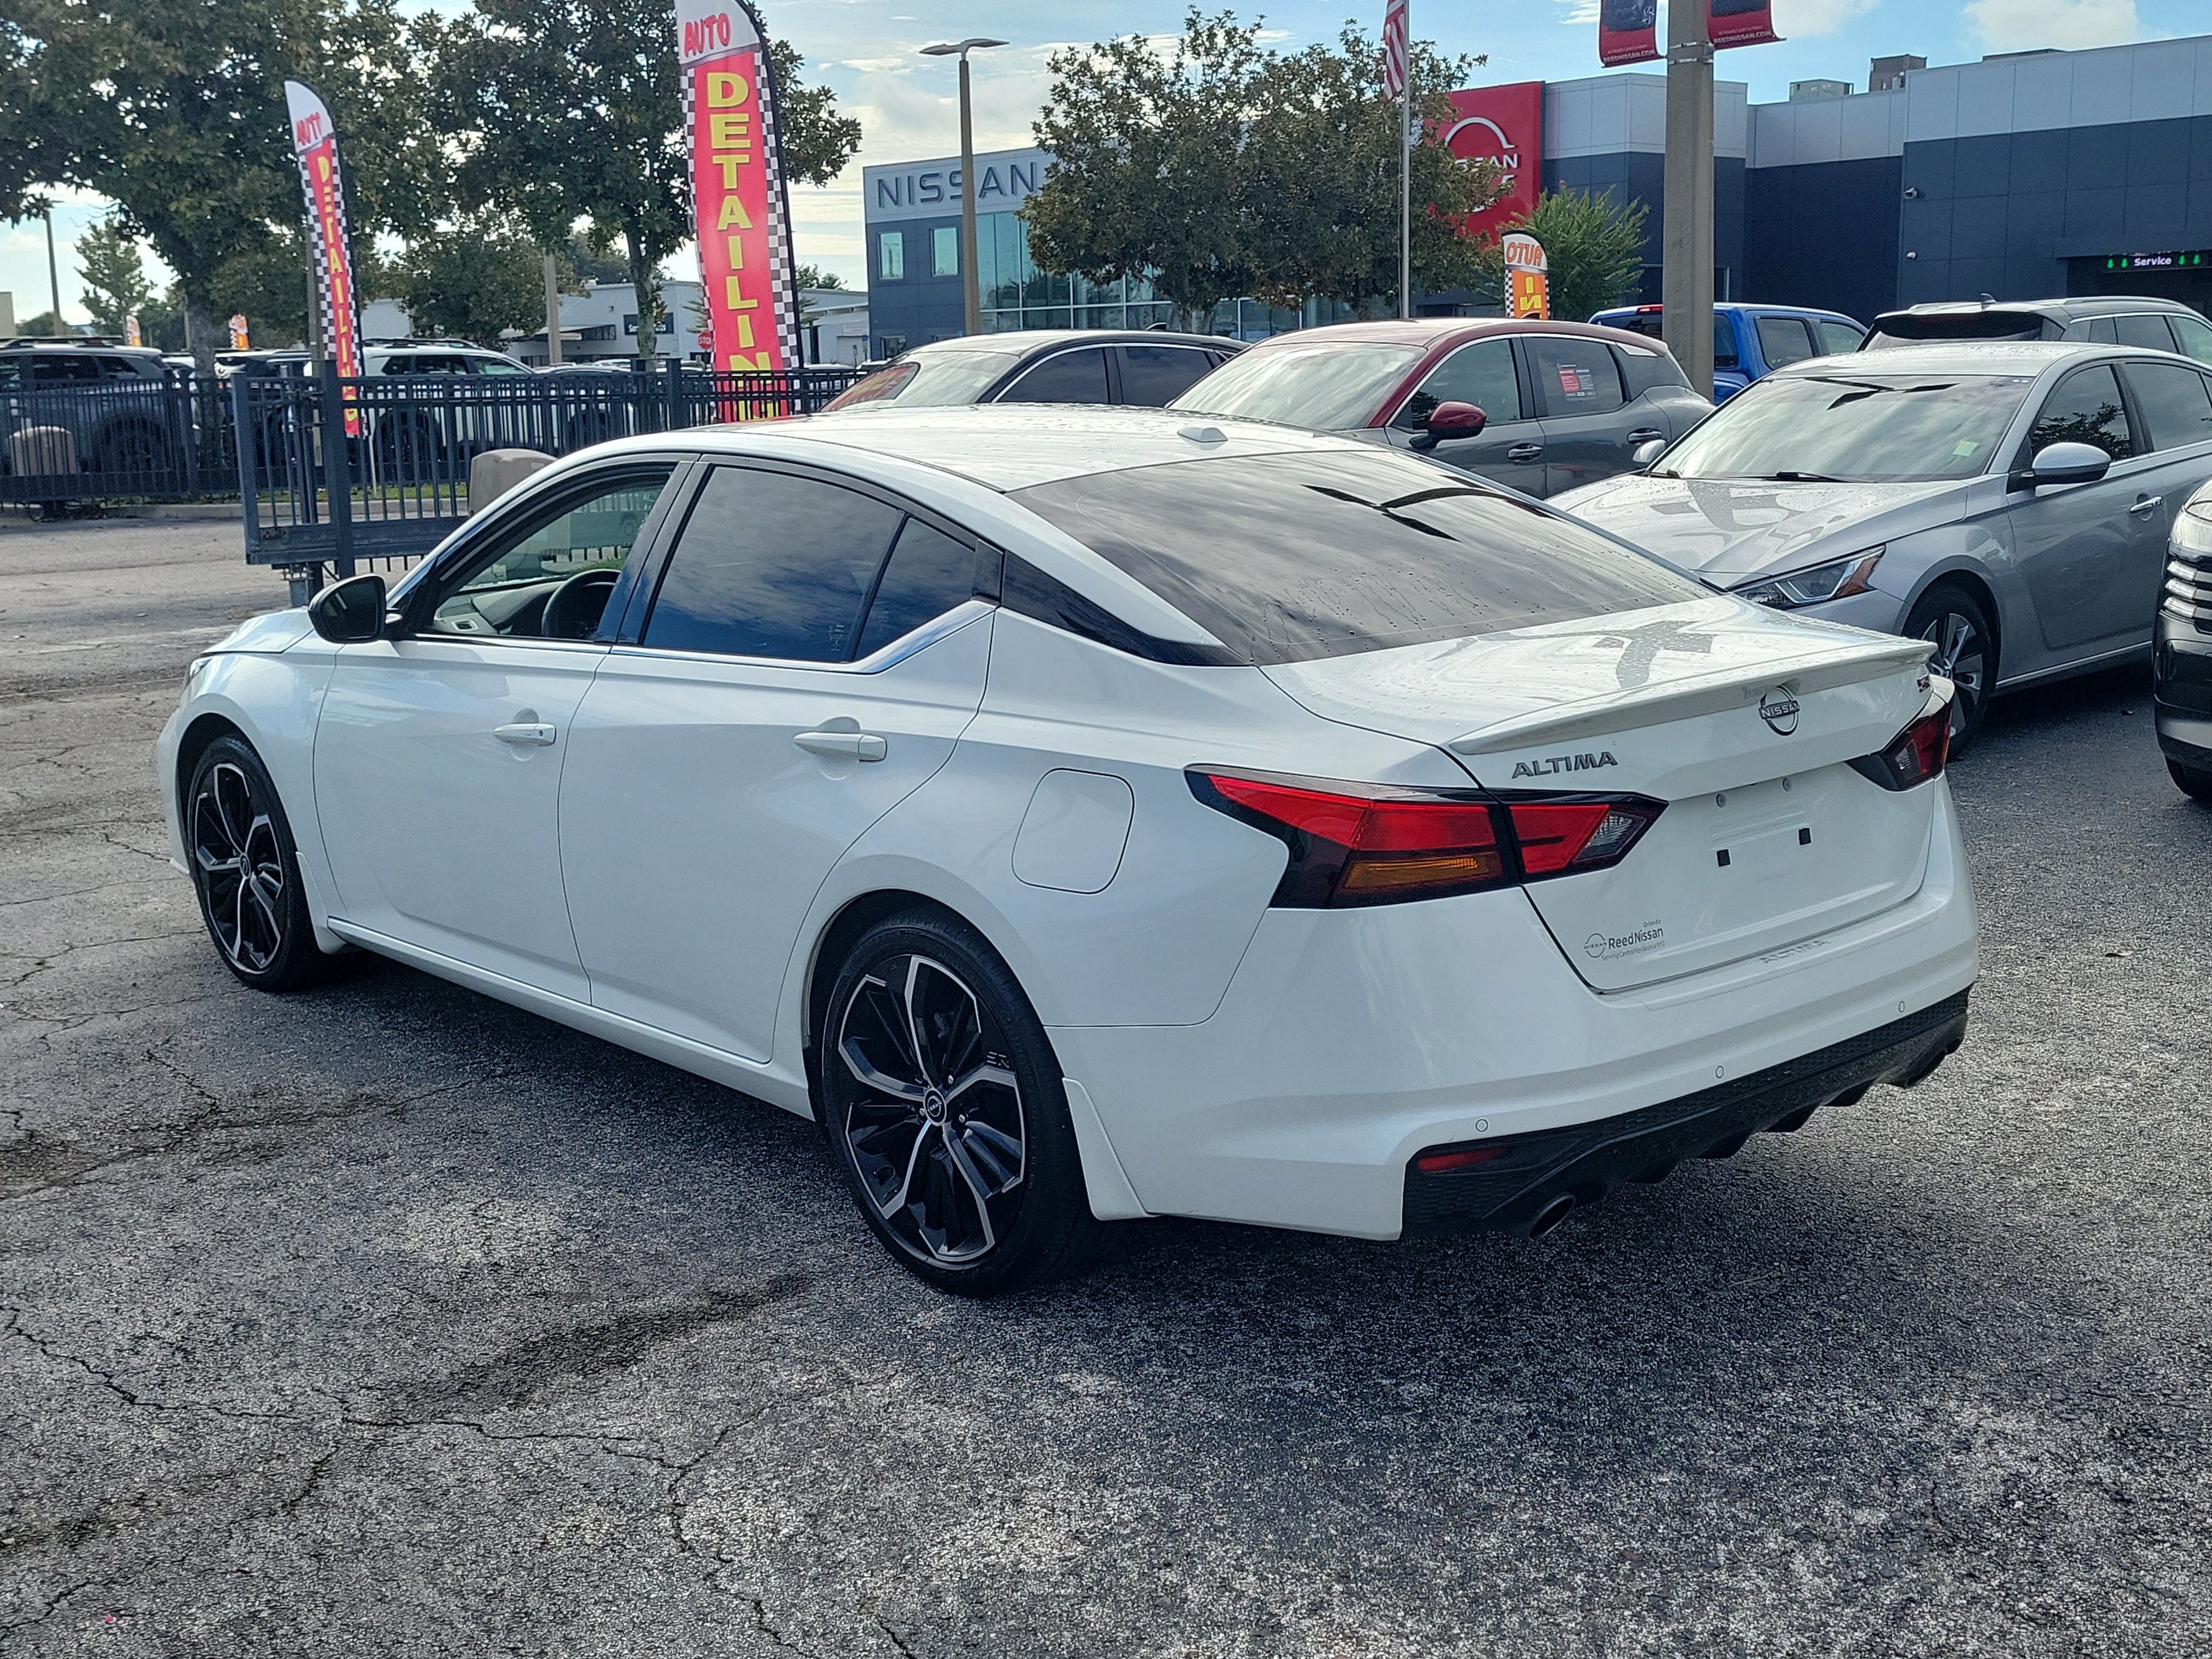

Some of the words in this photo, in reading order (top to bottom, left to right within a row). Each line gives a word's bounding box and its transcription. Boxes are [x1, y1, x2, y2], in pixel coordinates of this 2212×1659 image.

[684, 13, 730, 55] AUTO
[2134, 256, 2172, 267] Service
[1762, 703, 1799, 718] NISSAN
[1511, 751, 1618, 779] ALTIMA
